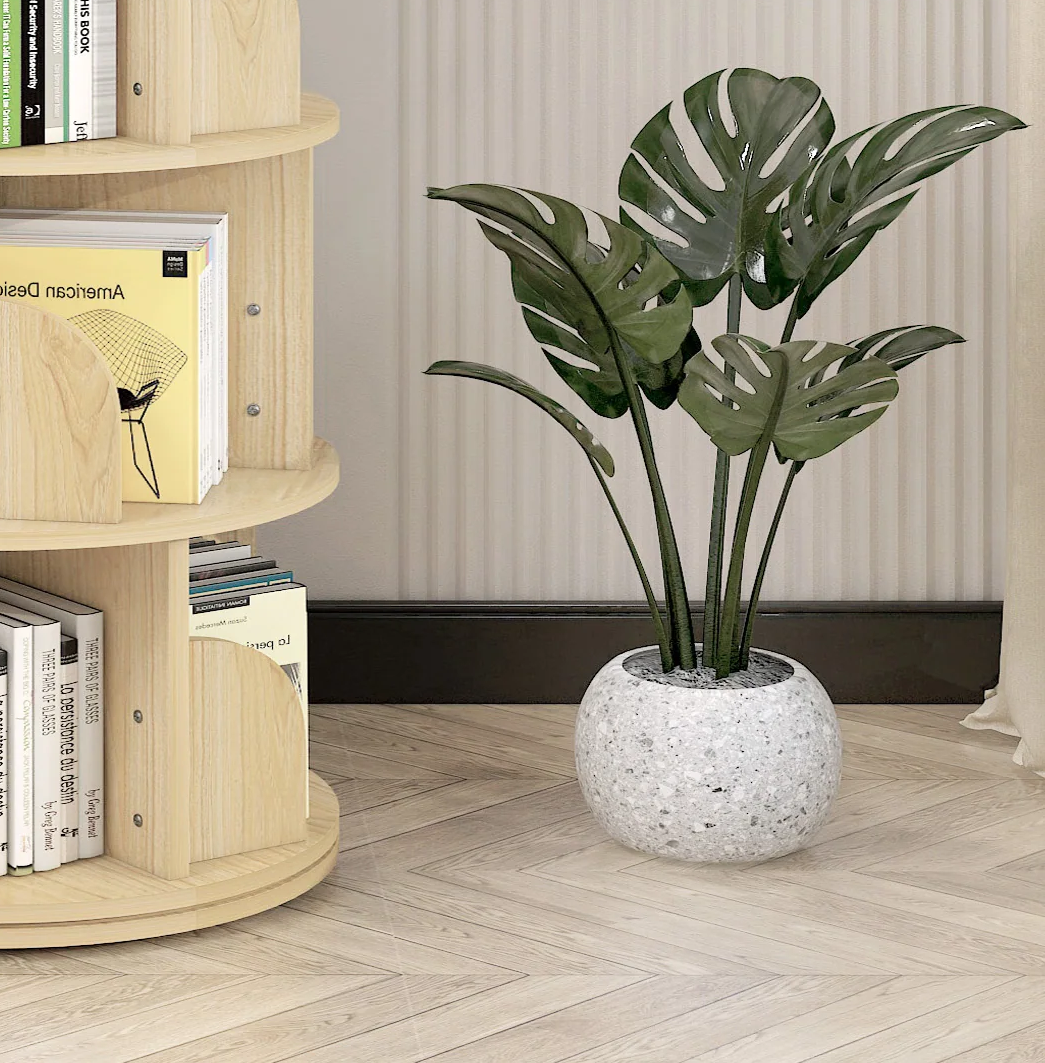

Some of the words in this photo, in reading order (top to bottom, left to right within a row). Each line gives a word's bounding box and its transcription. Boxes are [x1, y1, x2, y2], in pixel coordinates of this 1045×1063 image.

[27, 5, 38, 36] Security
[29, 37, 38, 50] and
[80, 20, 91, 54] BOOK
[27, 52, 38, 89] Insecurity
[42, 648, 56, 671] THREE
[85, 637, 100, 660] THREE
[42, 672, 56, 693] PAIRS
[85, 661, 100, 682] PAIRS
[60, 681, 78, 694] La
[85, 683, 100, 693] OF
[42, 694, 56, 704] OF
[85, 694, 100, 725] GLASSES
[42, 705, 56, 737] GLASSES
[60, 697, 78, 756] persistance
[60, 758, 78, 772] du
[60, 774, 78, 805] destin
[85, 788, 101, 797] by
[42, 801, 57, 809] by
[85, 798, 101, 815] Greg
[42, 810, 57, 827] Greg
[85, 816, 101, 839] Bennet
[42, 828, 57, 851] Bennet
